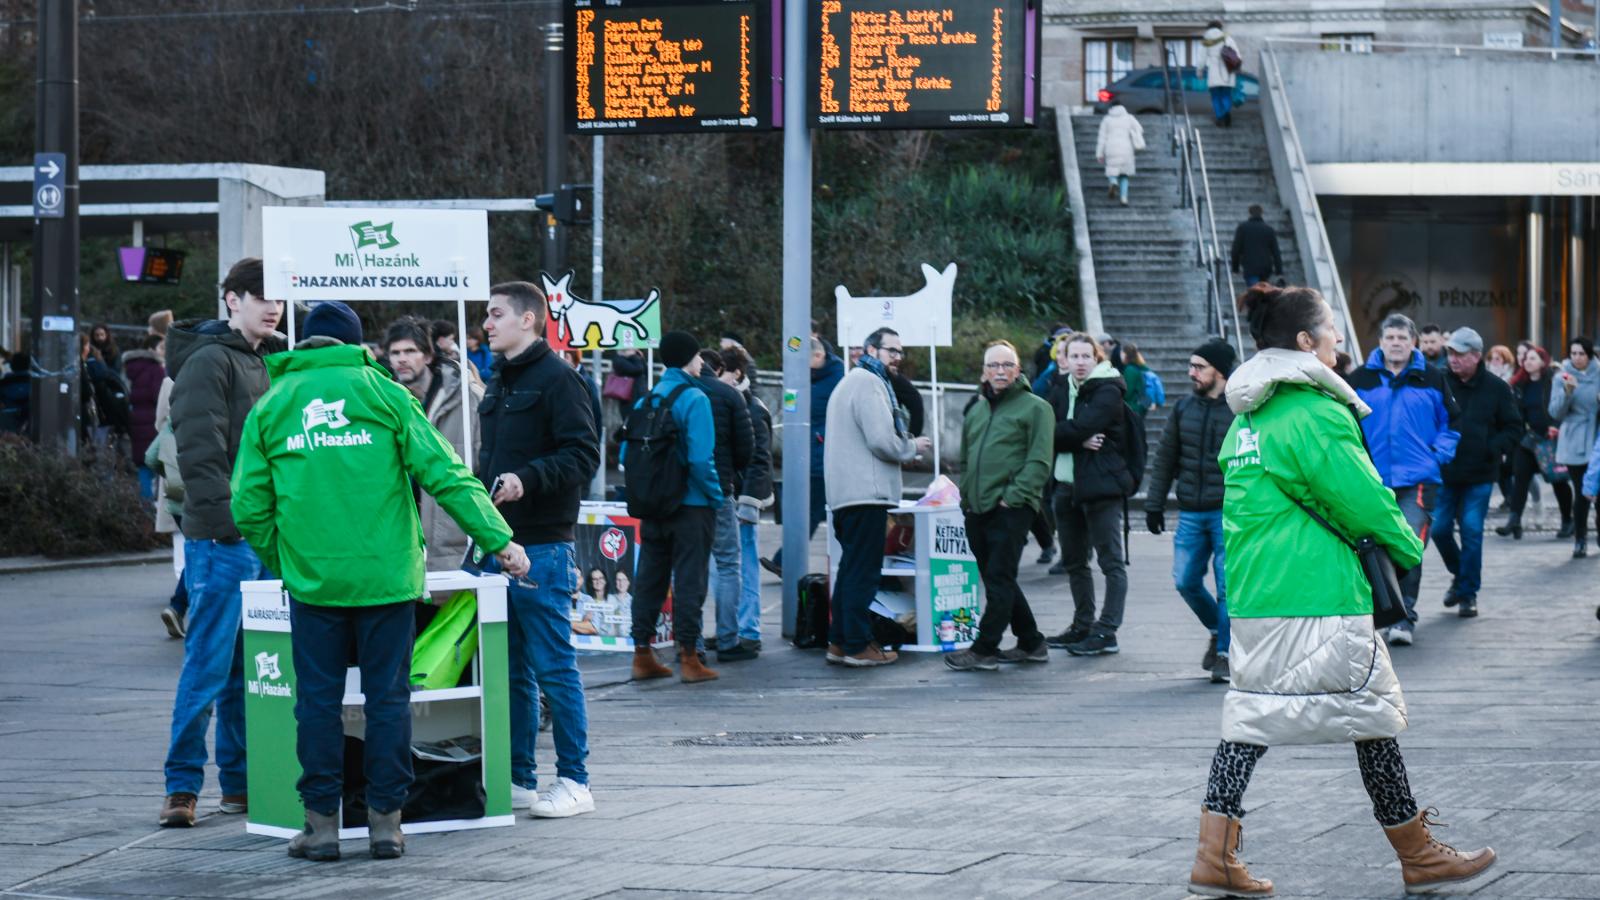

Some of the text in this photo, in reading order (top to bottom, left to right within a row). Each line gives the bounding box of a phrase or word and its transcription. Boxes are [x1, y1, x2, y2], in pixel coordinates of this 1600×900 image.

[942, 9, 953, 21] M
[641, 18, 662, 30] Park
[933, 20, 943, 33] M
[909, 32, 938, 45] Tesco
[940, 31, 977, 44] áruház
[683, 39, 702, 51] tér)
[701, 60, 711, 72] M
[897, 66, 914, 78] tér
[605, 74, 640, 85] Márton
[669, 72, 685, 84] tér
[666, 84, 682, 95] tér
[685, 82, 695, 94] M
[653, 95, 669, 106] tér
[893, 99, 910, 111] tér
[679, 104, 695, 116] tér
[1558, 167, 1600, 188] Sán
[335, 252, 420, 267] Mi Hazánk
[287, 429, 373, 451] Mi Hazánk
[935, 525, 966, 539] KÉTFAR
[935, 538, 968, 555] KUTYA
[248, 680, 292, 697] Mi Hazánk
